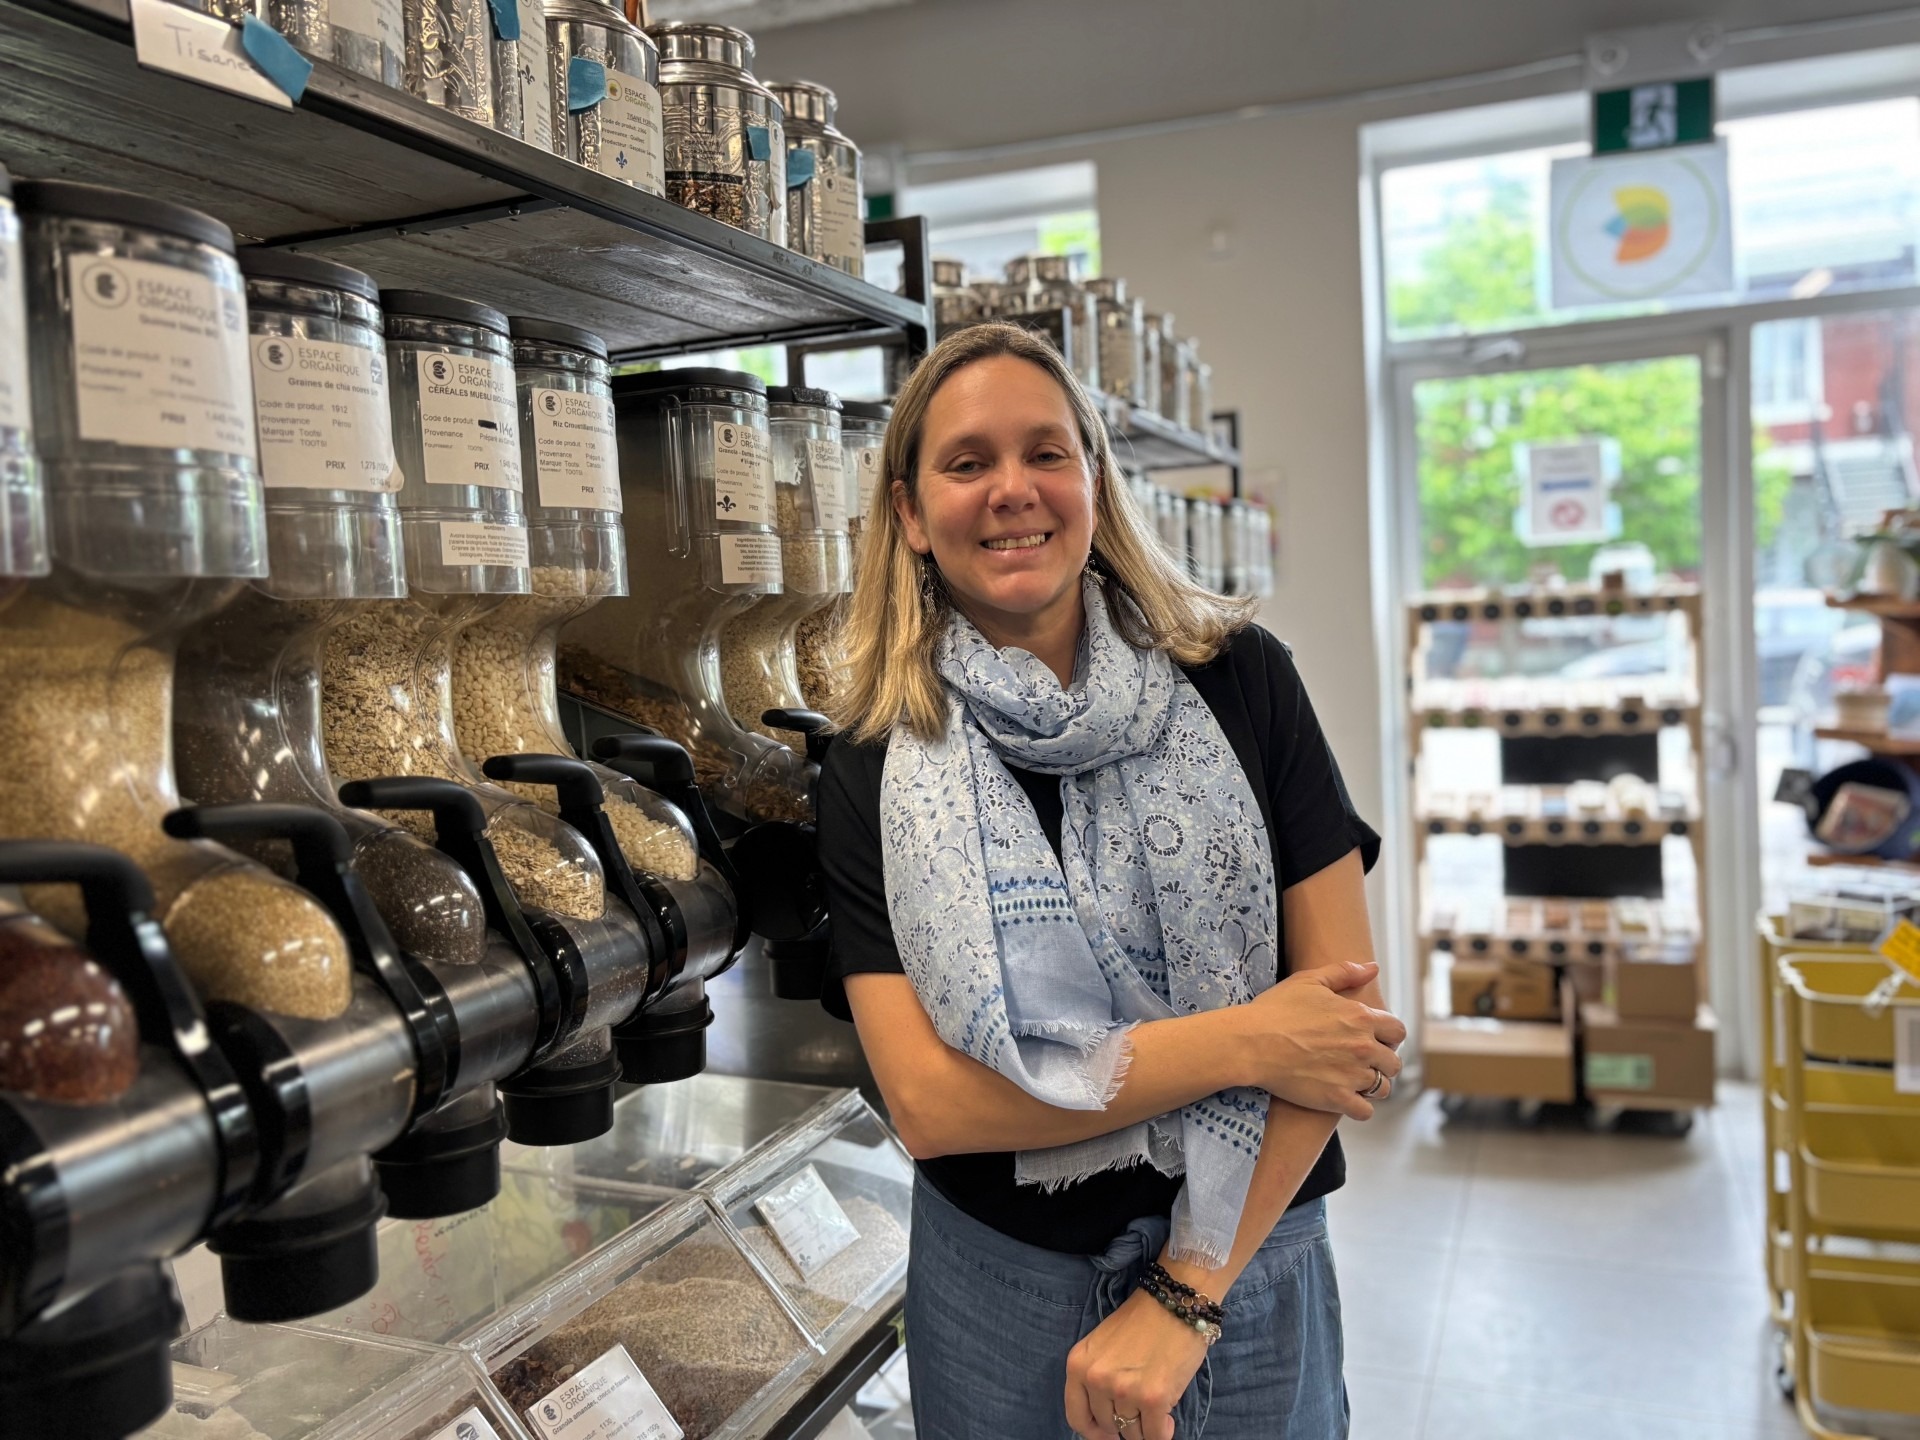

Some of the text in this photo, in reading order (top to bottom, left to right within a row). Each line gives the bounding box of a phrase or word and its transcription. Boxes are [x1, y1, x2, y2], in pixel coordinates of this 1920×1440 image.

[624, 87, 646, 101] ESPACE
[136, 278, 193, 301] ESPACE
[136, 294, 219, 325] ORGANIQUE
[298, 347, 341, 362] ESPACE
[299, 359, 360, 378] ORGANIQUE
[458, 363, 492, 378] ESPACE
[288, 377, 322, 390] Graines
[324, 381, 334, 390] de
[336, 382, 350, 392] chia
[458, 374, 505, 393] ORGANIQUE
[428, 384, 469, 398] CÉRÉALES
[469, 390, 492, 402] MUESLI
[258, 399, 282, 410] Code
[284, 401, 295, 410] de
[565, 398, 592, 410] ESPACE
[422, 413, 442, 423] Code
[443, 415, 452, 423] de
[565, 406, 602, 421] ORGANIQUE
[260, 415, 311, 426] Provenance
[552, 420, 563, 428] Riz
[262, 427, 295, 438] Marque
[424, 428, 464, 439] Provenance
[741, 431, 761, 442] ESPACE
[538, 438, 555, 446] Code
[539, 450, 573, 459] Provenance
[325, 459, 346, 471] PRIX
[474, 461, 490, 471] PRIX
[539, 460, 562, 468] Marque
[581, 485, 595, 494] PRIX
[559, 1377, 590, 1403] ESPACE
[565, 1376, 609, 1411] ORGANIQUE
[552, 1416, 574, 1435] Granola
[571, 1398, 599, 1423] amandes,
